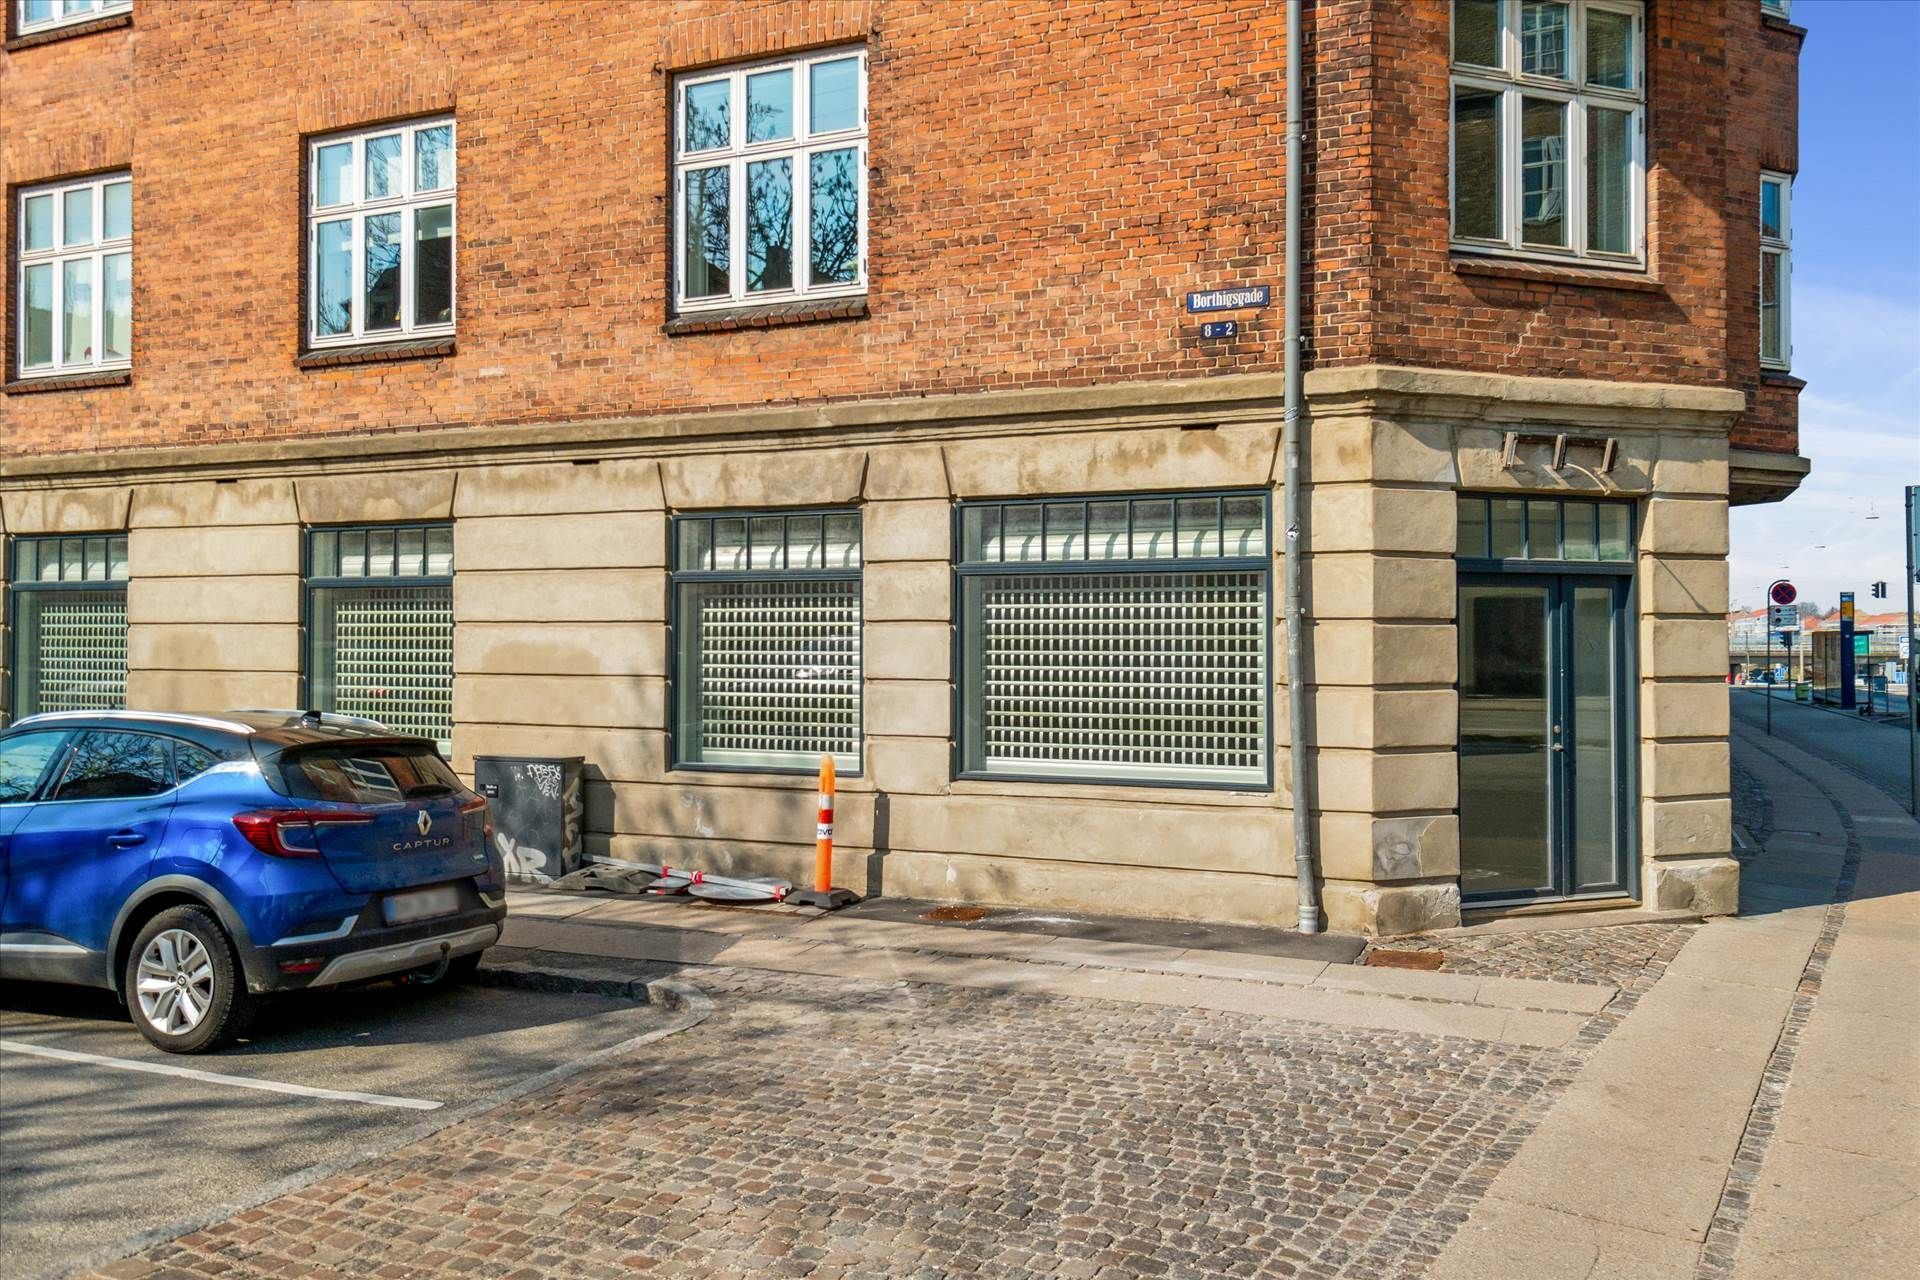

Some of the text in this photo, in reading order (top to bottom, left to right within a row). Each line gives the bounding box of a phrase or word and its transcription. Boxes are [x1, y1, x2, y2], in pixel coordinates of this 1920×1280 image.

[1193, 289, 1263, 308] Borthigsgade
[1204, 324, 1212, 337] 8
[1225, 322, 1233, 336] 2
[393, 837, 450, 851] CAPTUR
